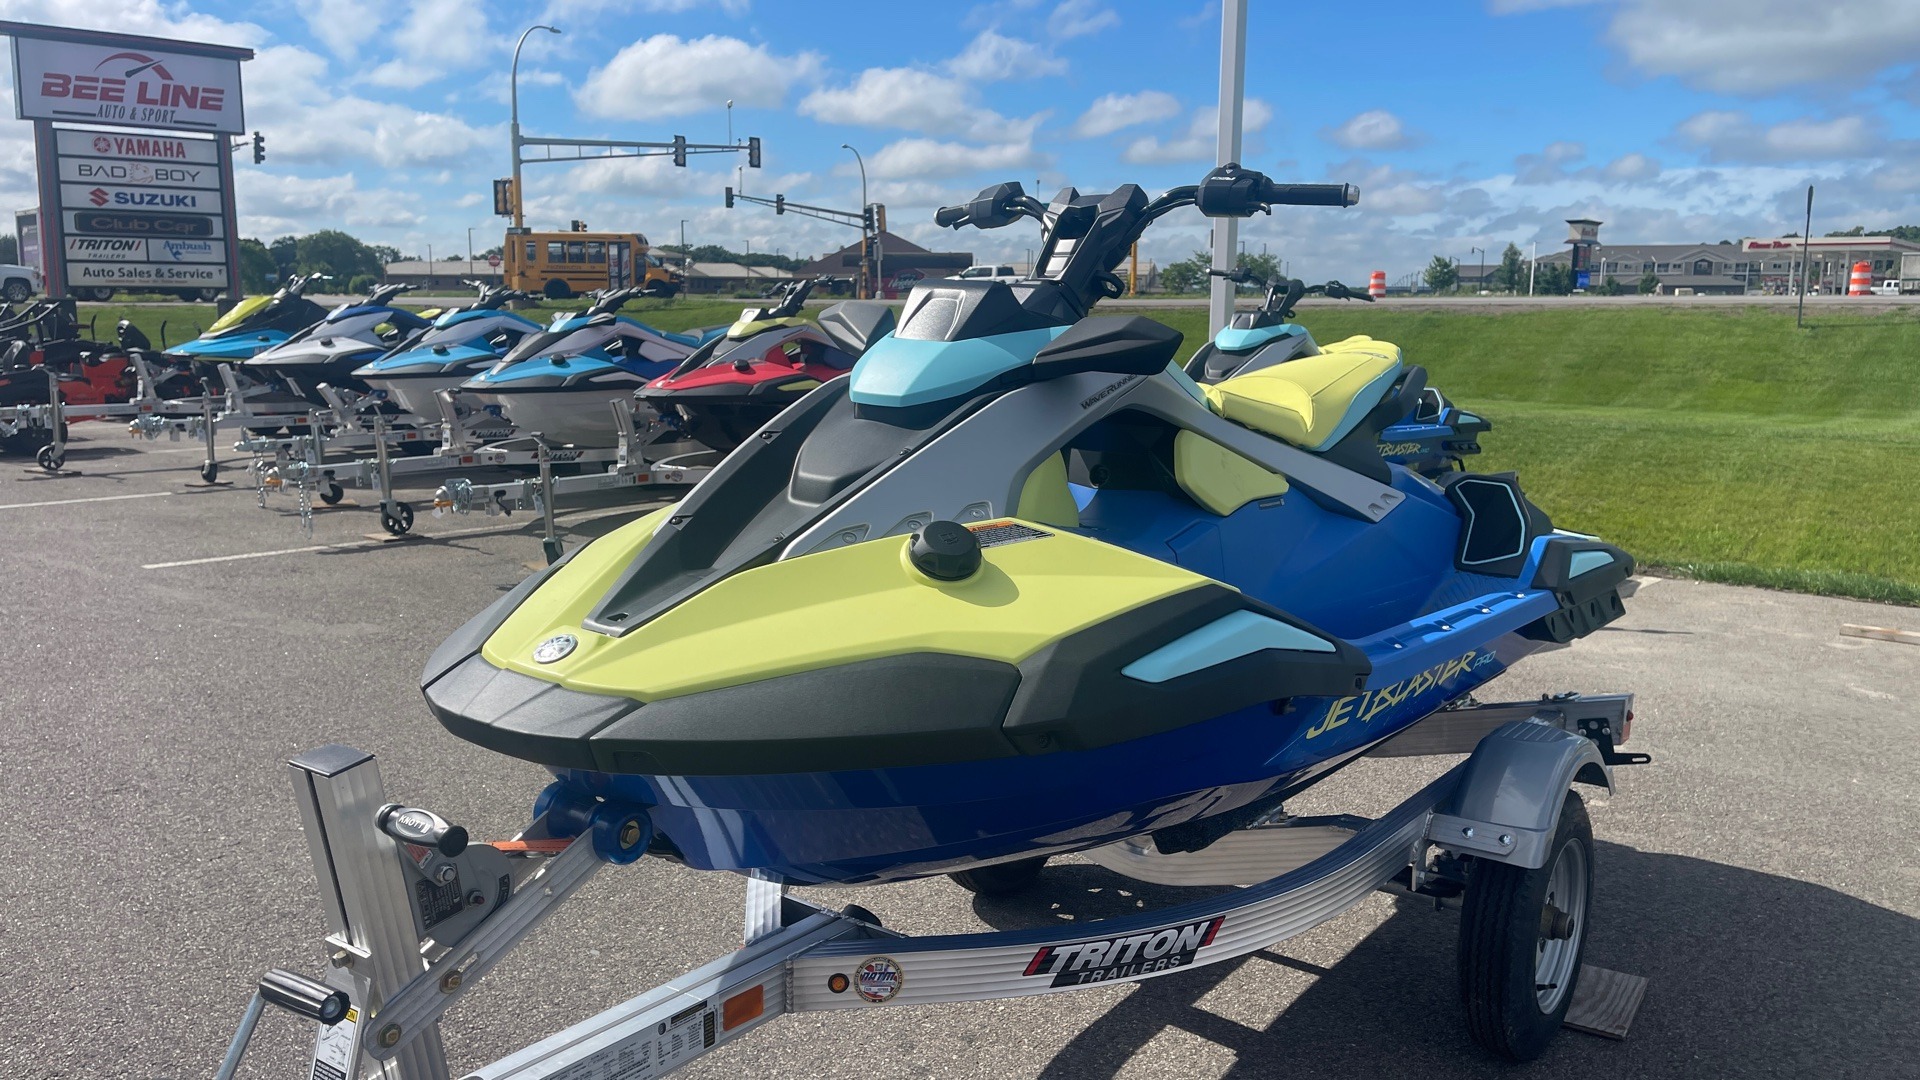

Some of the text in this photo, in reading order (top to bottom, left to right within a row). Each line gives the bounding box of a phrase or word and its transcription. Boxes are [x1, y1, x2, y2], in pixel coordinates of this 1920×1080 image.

[41, 72, 225, 111] BEE LINE
[97, 104, 176, 124] AUTO & SPORT
[114, 137, 186, 159] YAMAHA
[78, 164, 201, 182] BAD BOY
[114, 191, 197, 208] SUZUKI
[91, 217, 197, 234] Club Car
[77, 239, 135, 251] TRITON
[163, 240, 212, 251] Ambush
[83, 267, 213, 279] Auto Sales & Service
[1306, 650, 1497, 739] JETBLASTER PRO
[398, 814, 424, 830] KNOTT
[1048, 921, 1211, 974] TRITON
[1078, 955, 1181, 984] TRAILERS
